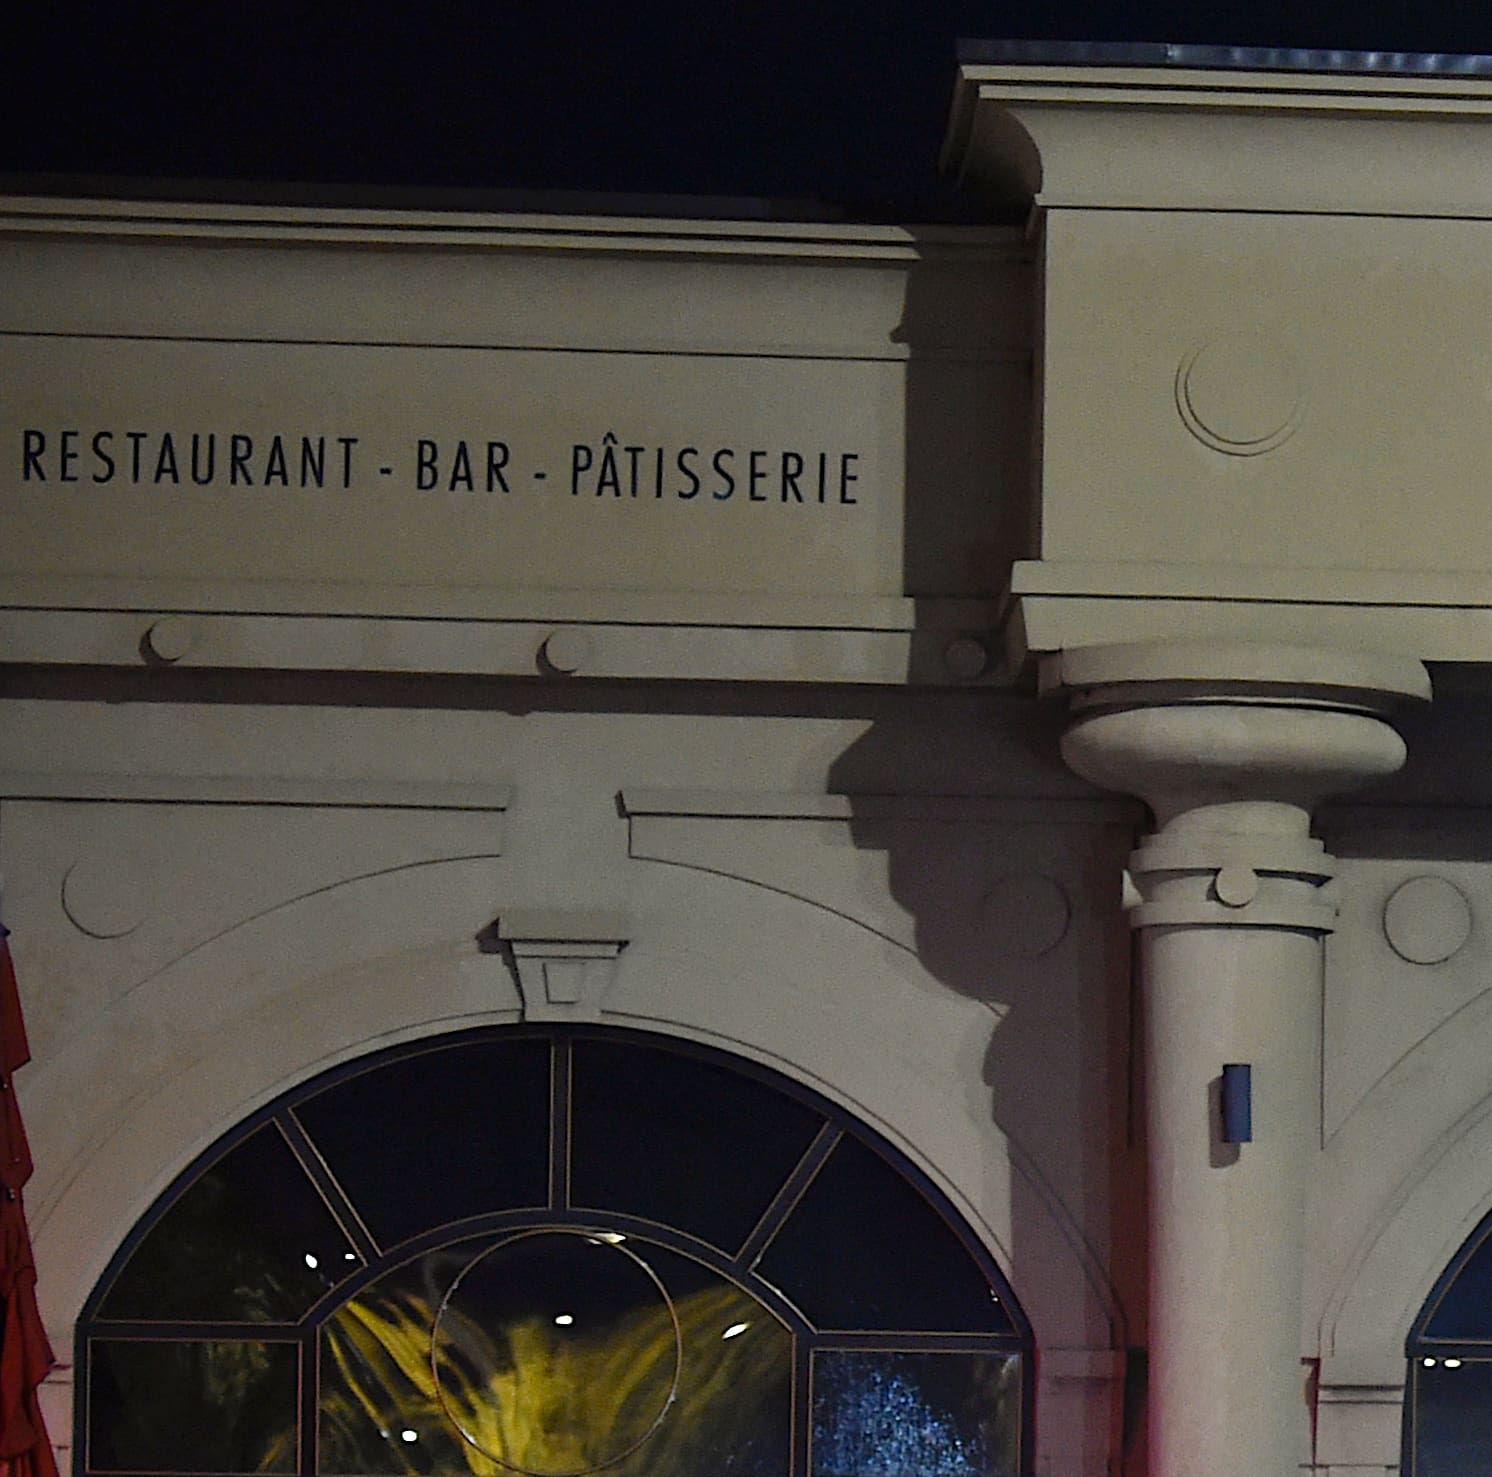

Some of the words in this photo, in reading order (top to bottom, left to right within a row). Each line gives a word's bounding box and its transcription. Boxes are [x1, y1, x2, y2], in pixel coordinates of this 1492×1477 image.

[22, 429, 359, 489] RESTAURANT
[416, 439, 510, 494] BAR
[571, 431, 860, 505] PÂTISSERIE
